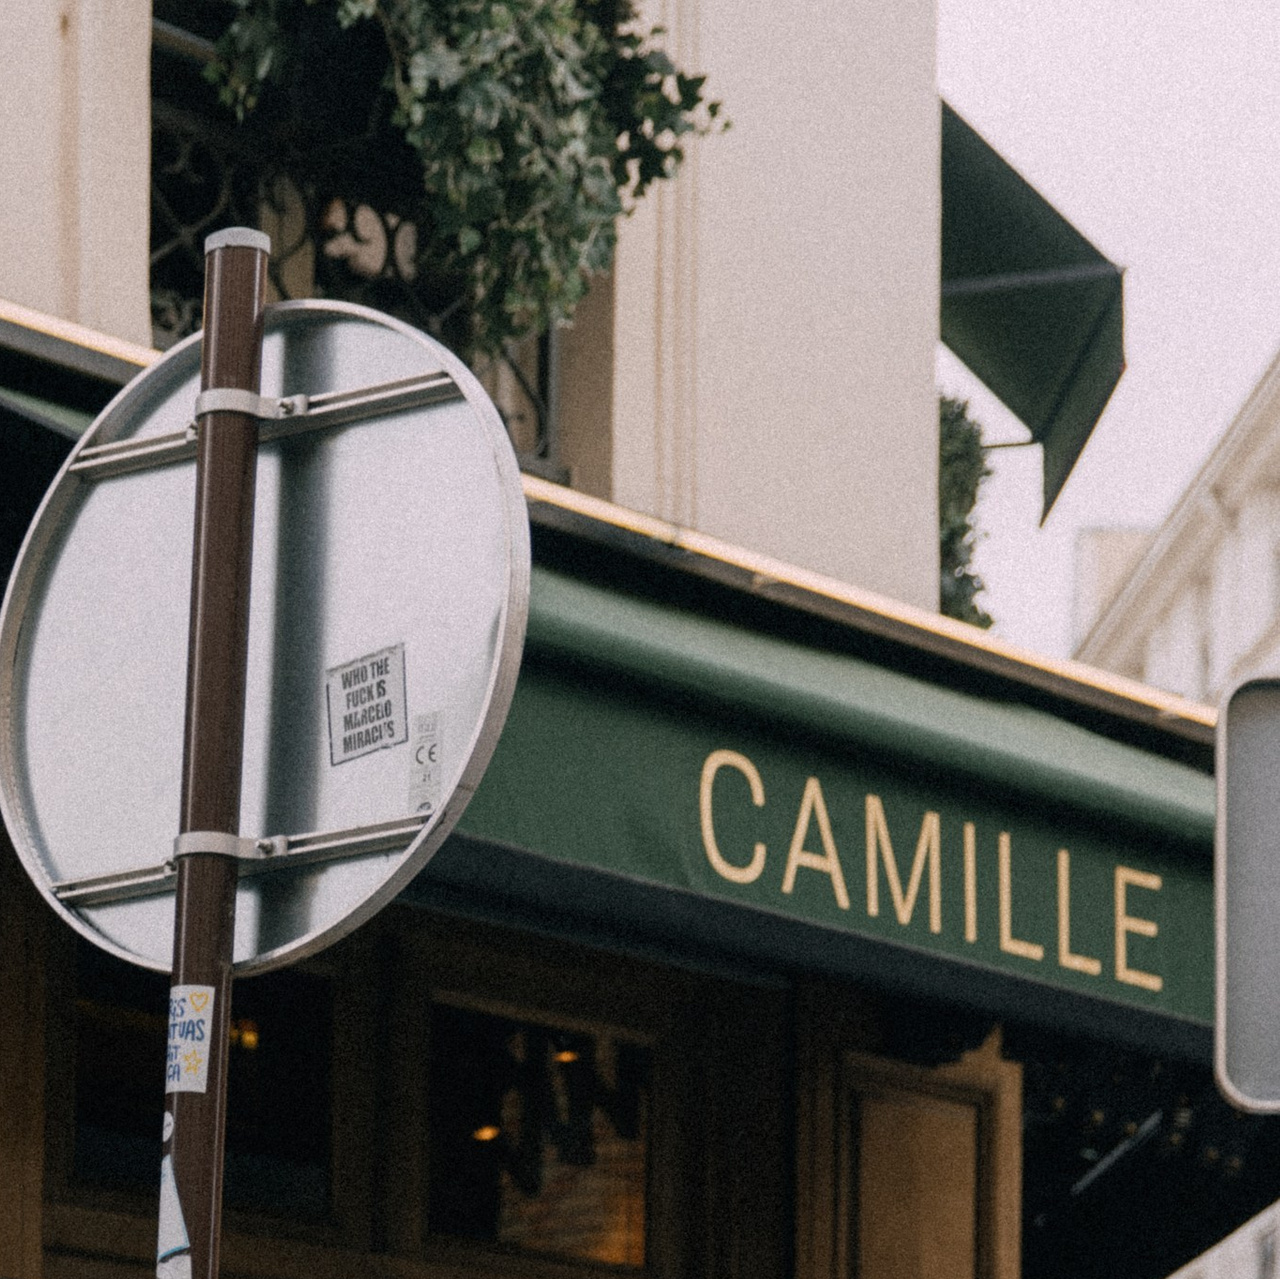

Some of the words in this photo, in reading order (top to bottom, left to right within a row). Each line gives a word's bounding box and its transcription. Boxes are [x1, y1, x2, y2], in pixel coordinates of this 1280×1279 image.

[341, 665, 368, 690] WHO
[370, 657, 390, 679] THE
[346, 684, 374, 710] FUCK
[376, 679, 386, 699] IS
[415, 743, 437, 765] CE
[700, 749, 1163, 992] CAMILLE
